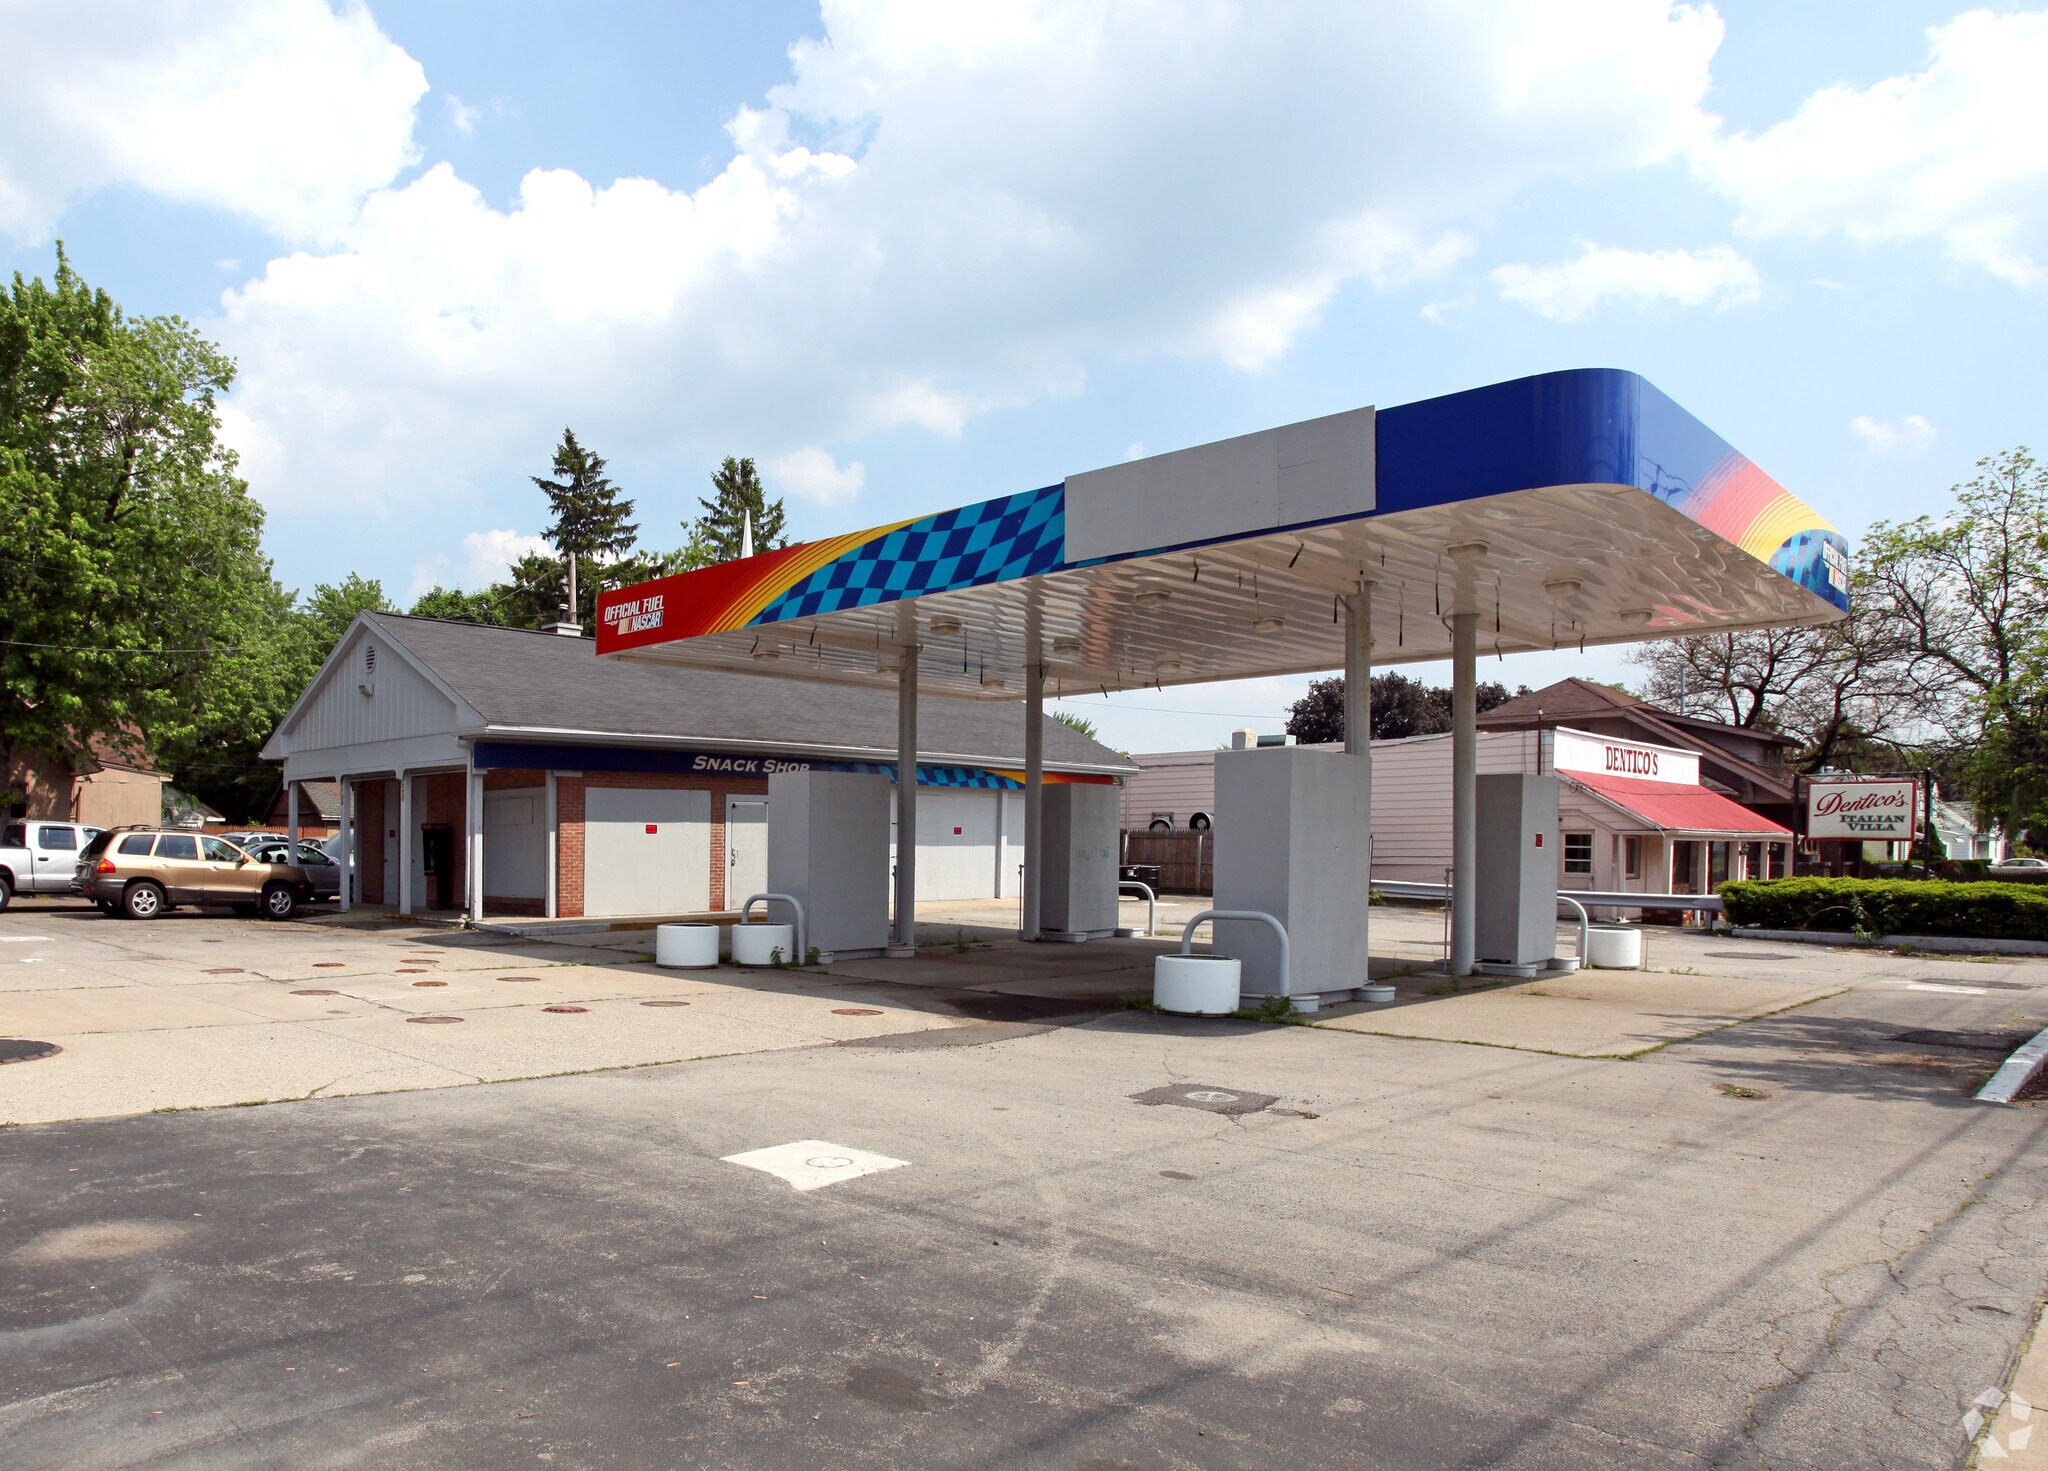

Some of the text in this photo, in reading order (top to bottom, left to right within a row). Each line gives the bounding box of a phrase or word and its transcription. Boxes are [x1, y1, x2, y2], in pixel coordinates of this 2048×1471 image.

[604, 595, 664, 622] OFFICIAL FUEL
[631, 610, 663, 632] NASCAR
[692, 755, 759, 772] SNACK
[1605, 746, 1659, 776] DENTICO'S
[1813, 790, 1909, 817] Dentico's
[1839, 815, 1906, 823] ITALIAN
[1848, 823, 1896, 831] VILLA
